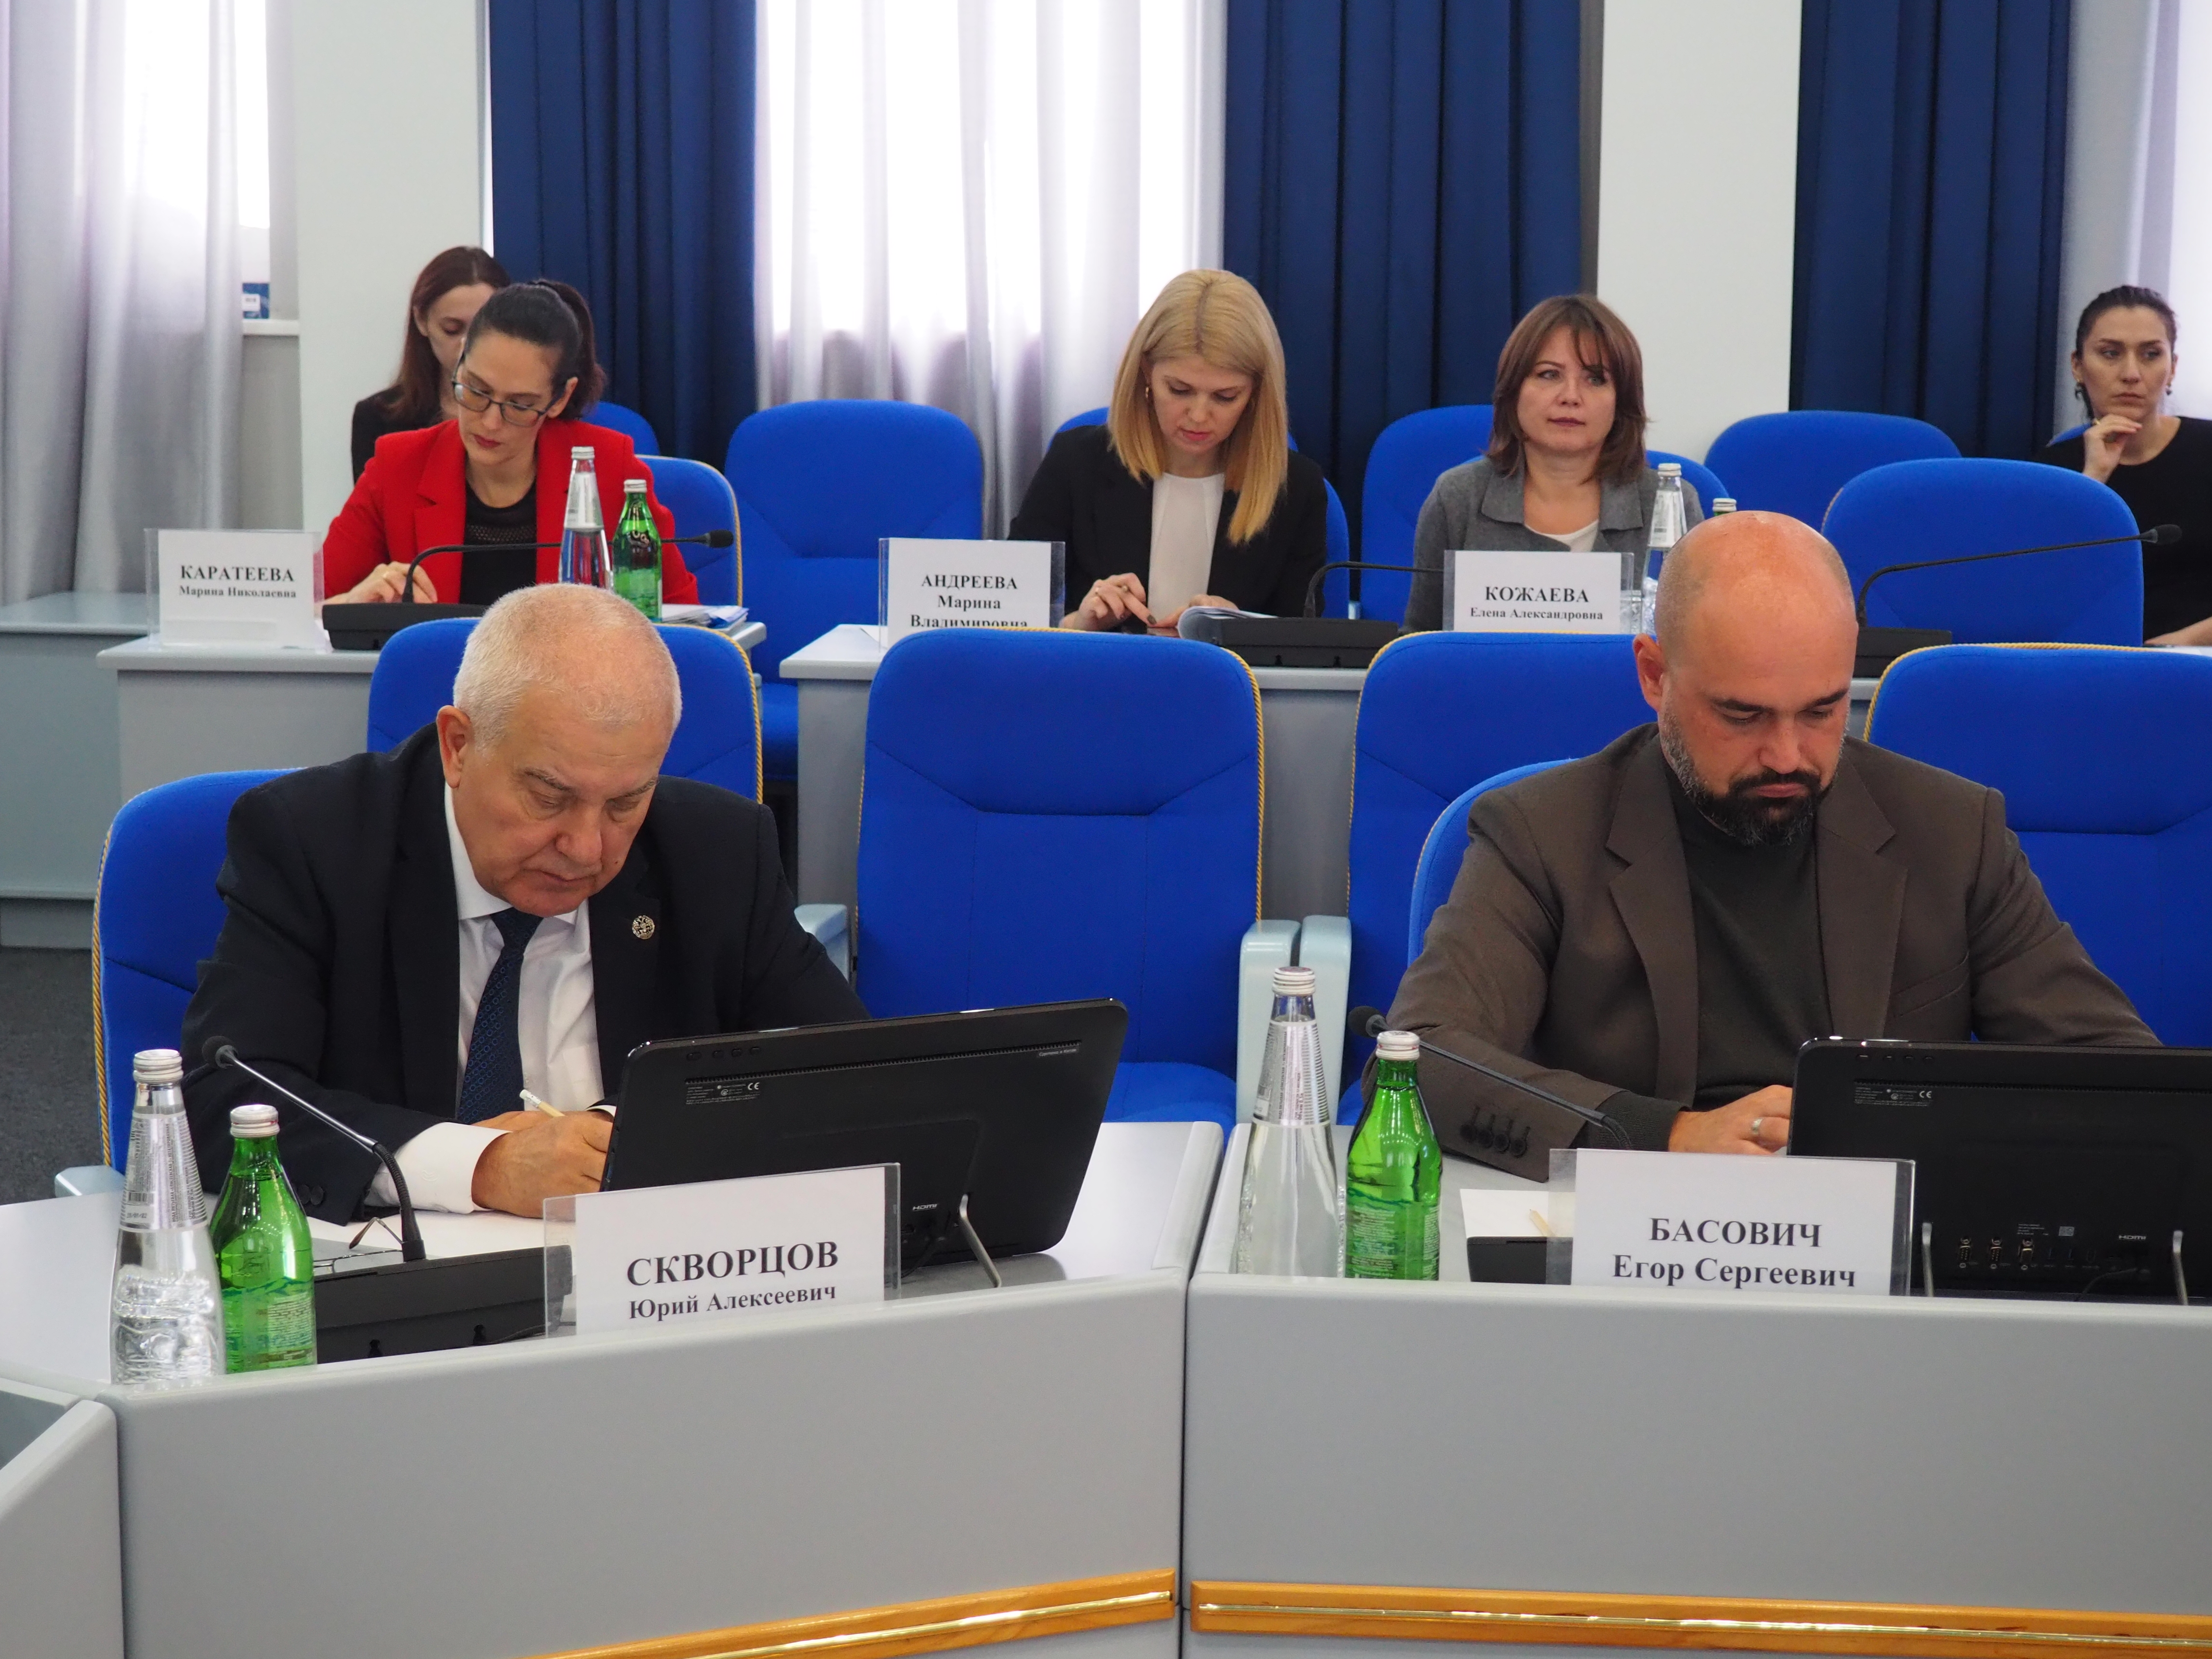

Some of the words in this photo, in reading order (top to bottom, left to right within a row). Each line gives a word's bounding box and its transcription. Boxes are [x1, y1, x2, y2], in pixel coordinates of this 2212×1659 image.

[180, 565, 295, 582] КАРАТЕЕВА
[921, 574, 1018, 590] АНДРЕЕВА
[179, 585, 224, 599] Марина
[228, 586, 297, 599] Николаевна
[1485, 586, 1589, 602] КОЖАЕВА
[938, 595, 1001, 612] Марина
[1470, 607, 1506, 618] Елена
[1510, 608, 1603, 622] Александровна
[1648, 1217, 1823, 1247] БАСОВИЧ
[627, 1241, 839, 1286] СКВОРЦОВ
[1612, 1254, 1684, 1286] Егор
[1695, 1257, 1856, 1289] Сергеевич
[629, 1295, 699, 1322] Юрий
[706, 1286, 836, 1311] Алексеевич
